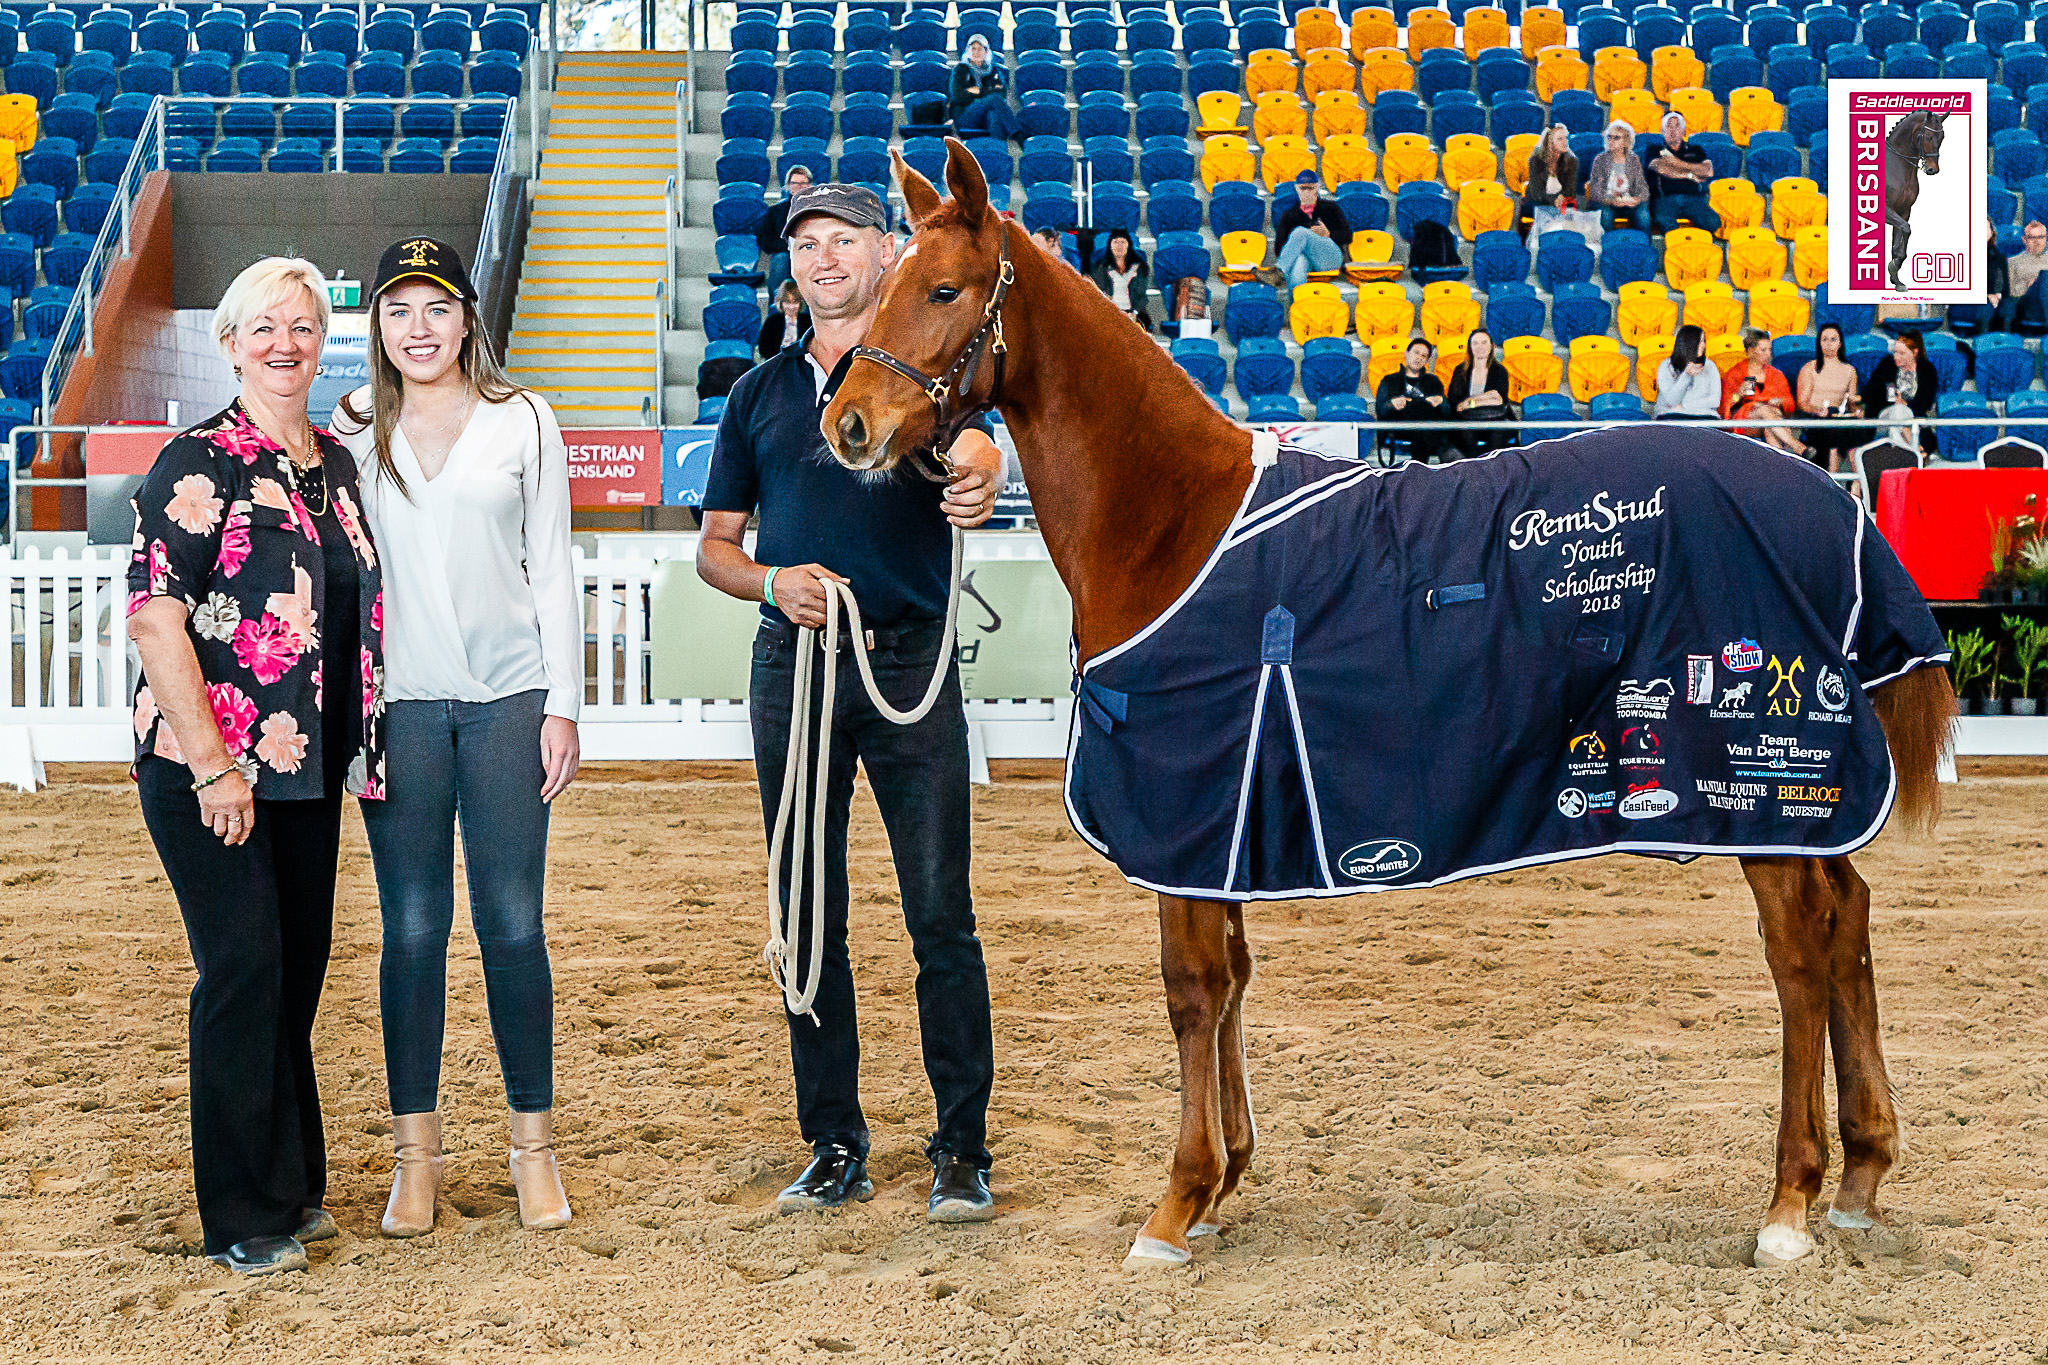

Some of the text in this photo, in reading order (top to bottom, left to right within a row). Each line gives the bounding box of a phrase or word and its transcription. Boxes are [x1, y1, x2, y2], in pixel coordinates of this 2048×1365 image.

[1561, 532, 1625, 569] Youth
[1541, 562, 1656, 603] Scholarship
[1581, 594, 1621, 614] 2018
[1766, 698, 1801, 716] AU
[1617, 710, 1667, 720] TOOWOOMBA
[1808, 711, 1834, 722] RICHARD
[1759, 734, 1798, 747] Team
[1726, 743, 1832, 761] Van Den Berge
[1568, 762, 1609, 770] EQUESTRIAN
[1619, 757, 1666, 765] EQUESTRIAN
[1735, 770, 1822, 779] www.teamvdb.com.au
[1730, 782, 1768, 798] EQUINE
[1349, 865, 1374, 875] EURO
